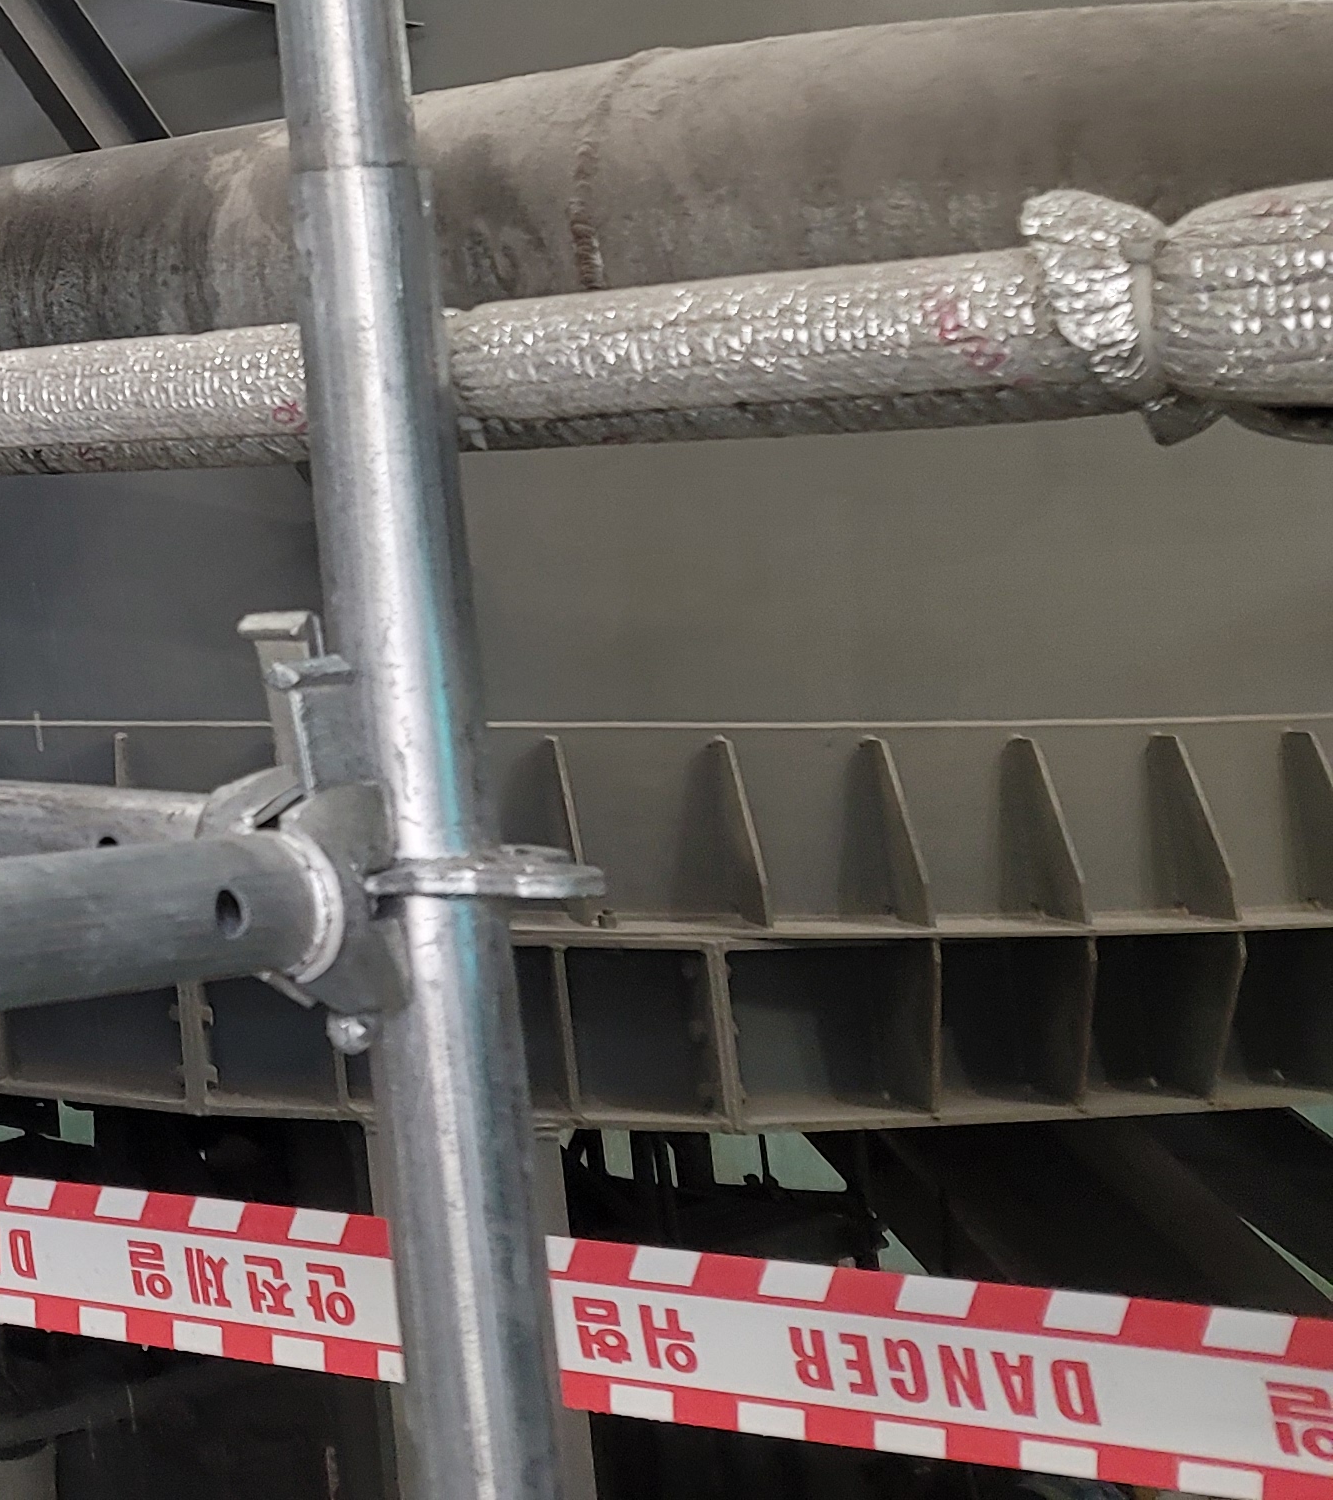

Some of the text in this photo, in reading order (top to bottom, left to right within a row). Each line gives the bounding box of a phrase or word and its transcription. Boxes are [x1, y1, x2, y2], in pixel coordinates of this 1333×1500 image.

[127, 1240, 356, 1326] 안전제일
[572, 1296, 698, 1373] 위험
[788, 1326, 1101, 1425] DANGER
